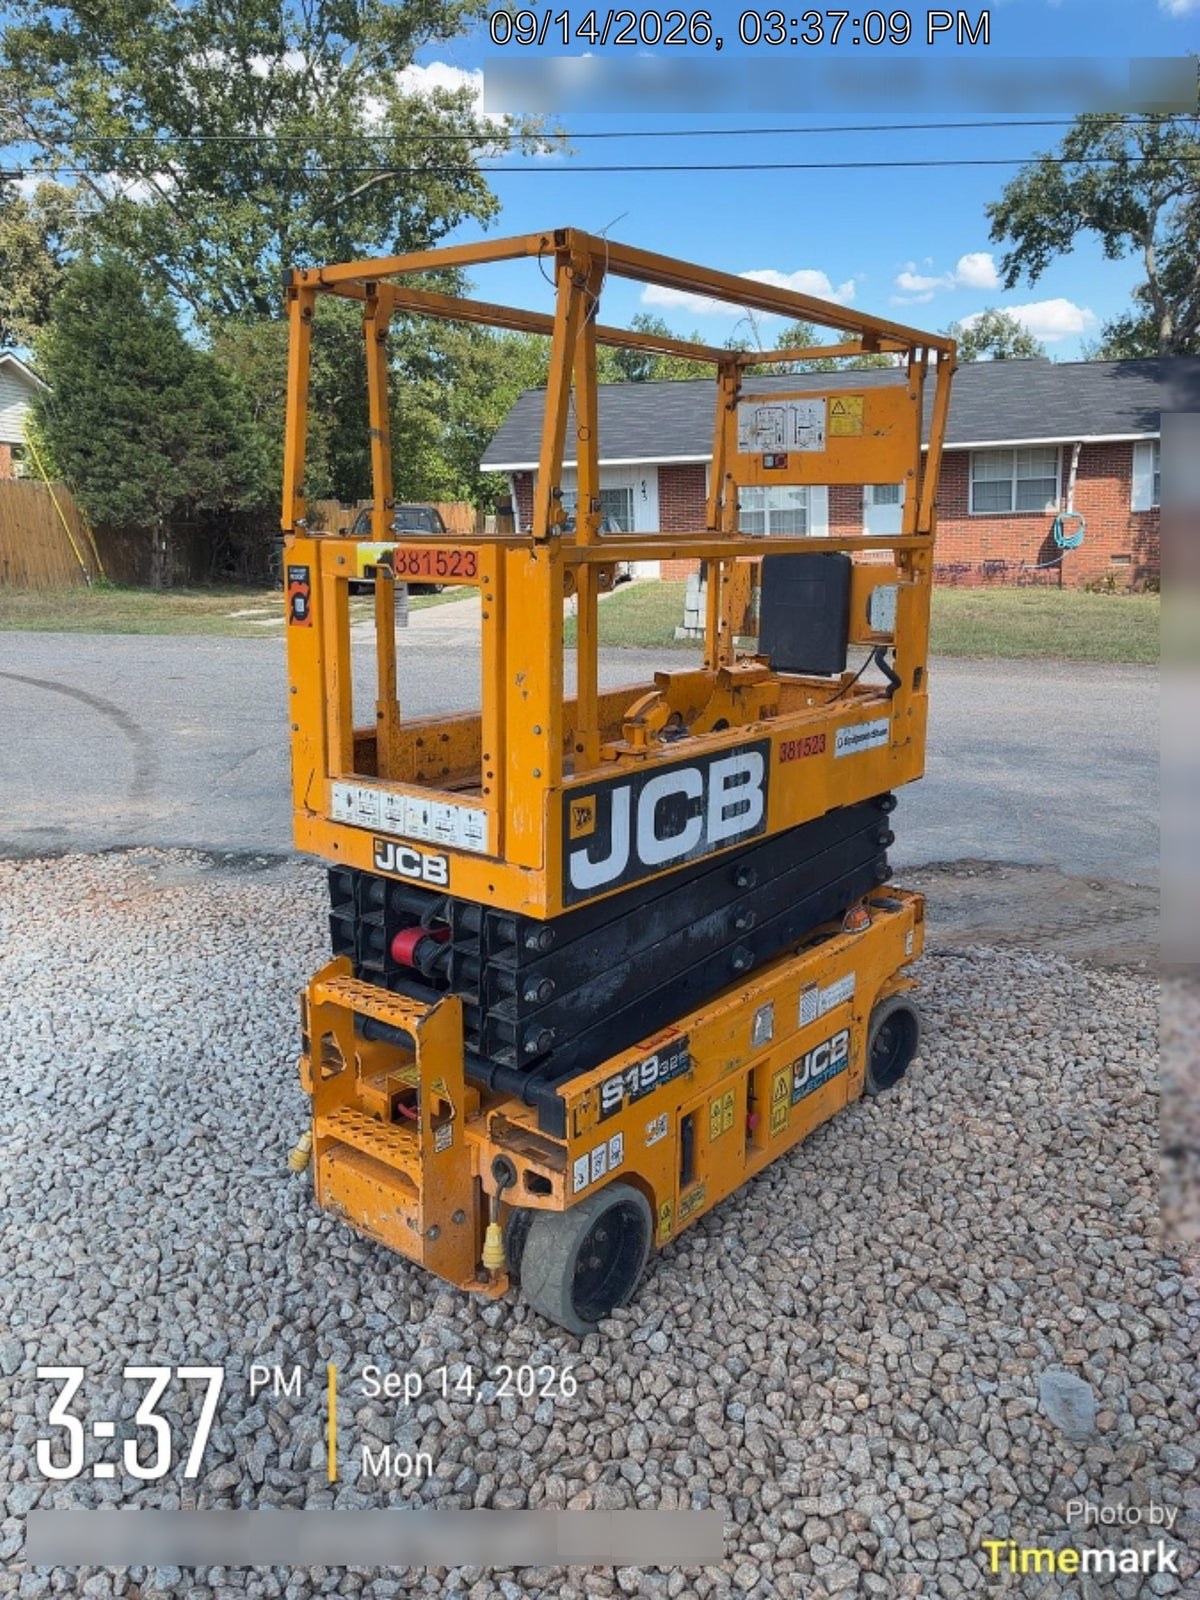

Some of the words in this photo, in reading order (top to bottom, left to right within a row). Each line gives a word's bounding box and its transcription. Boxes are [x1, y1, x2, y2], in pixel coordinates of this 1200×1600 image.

[396, 550, 477, 577] 381523
[780, 734, 826, 763] 381523
[569, 751, 765, 890] JCB
[375, 843, 448, 884] JCB
[794, 1030, 849, 1089] JCB
